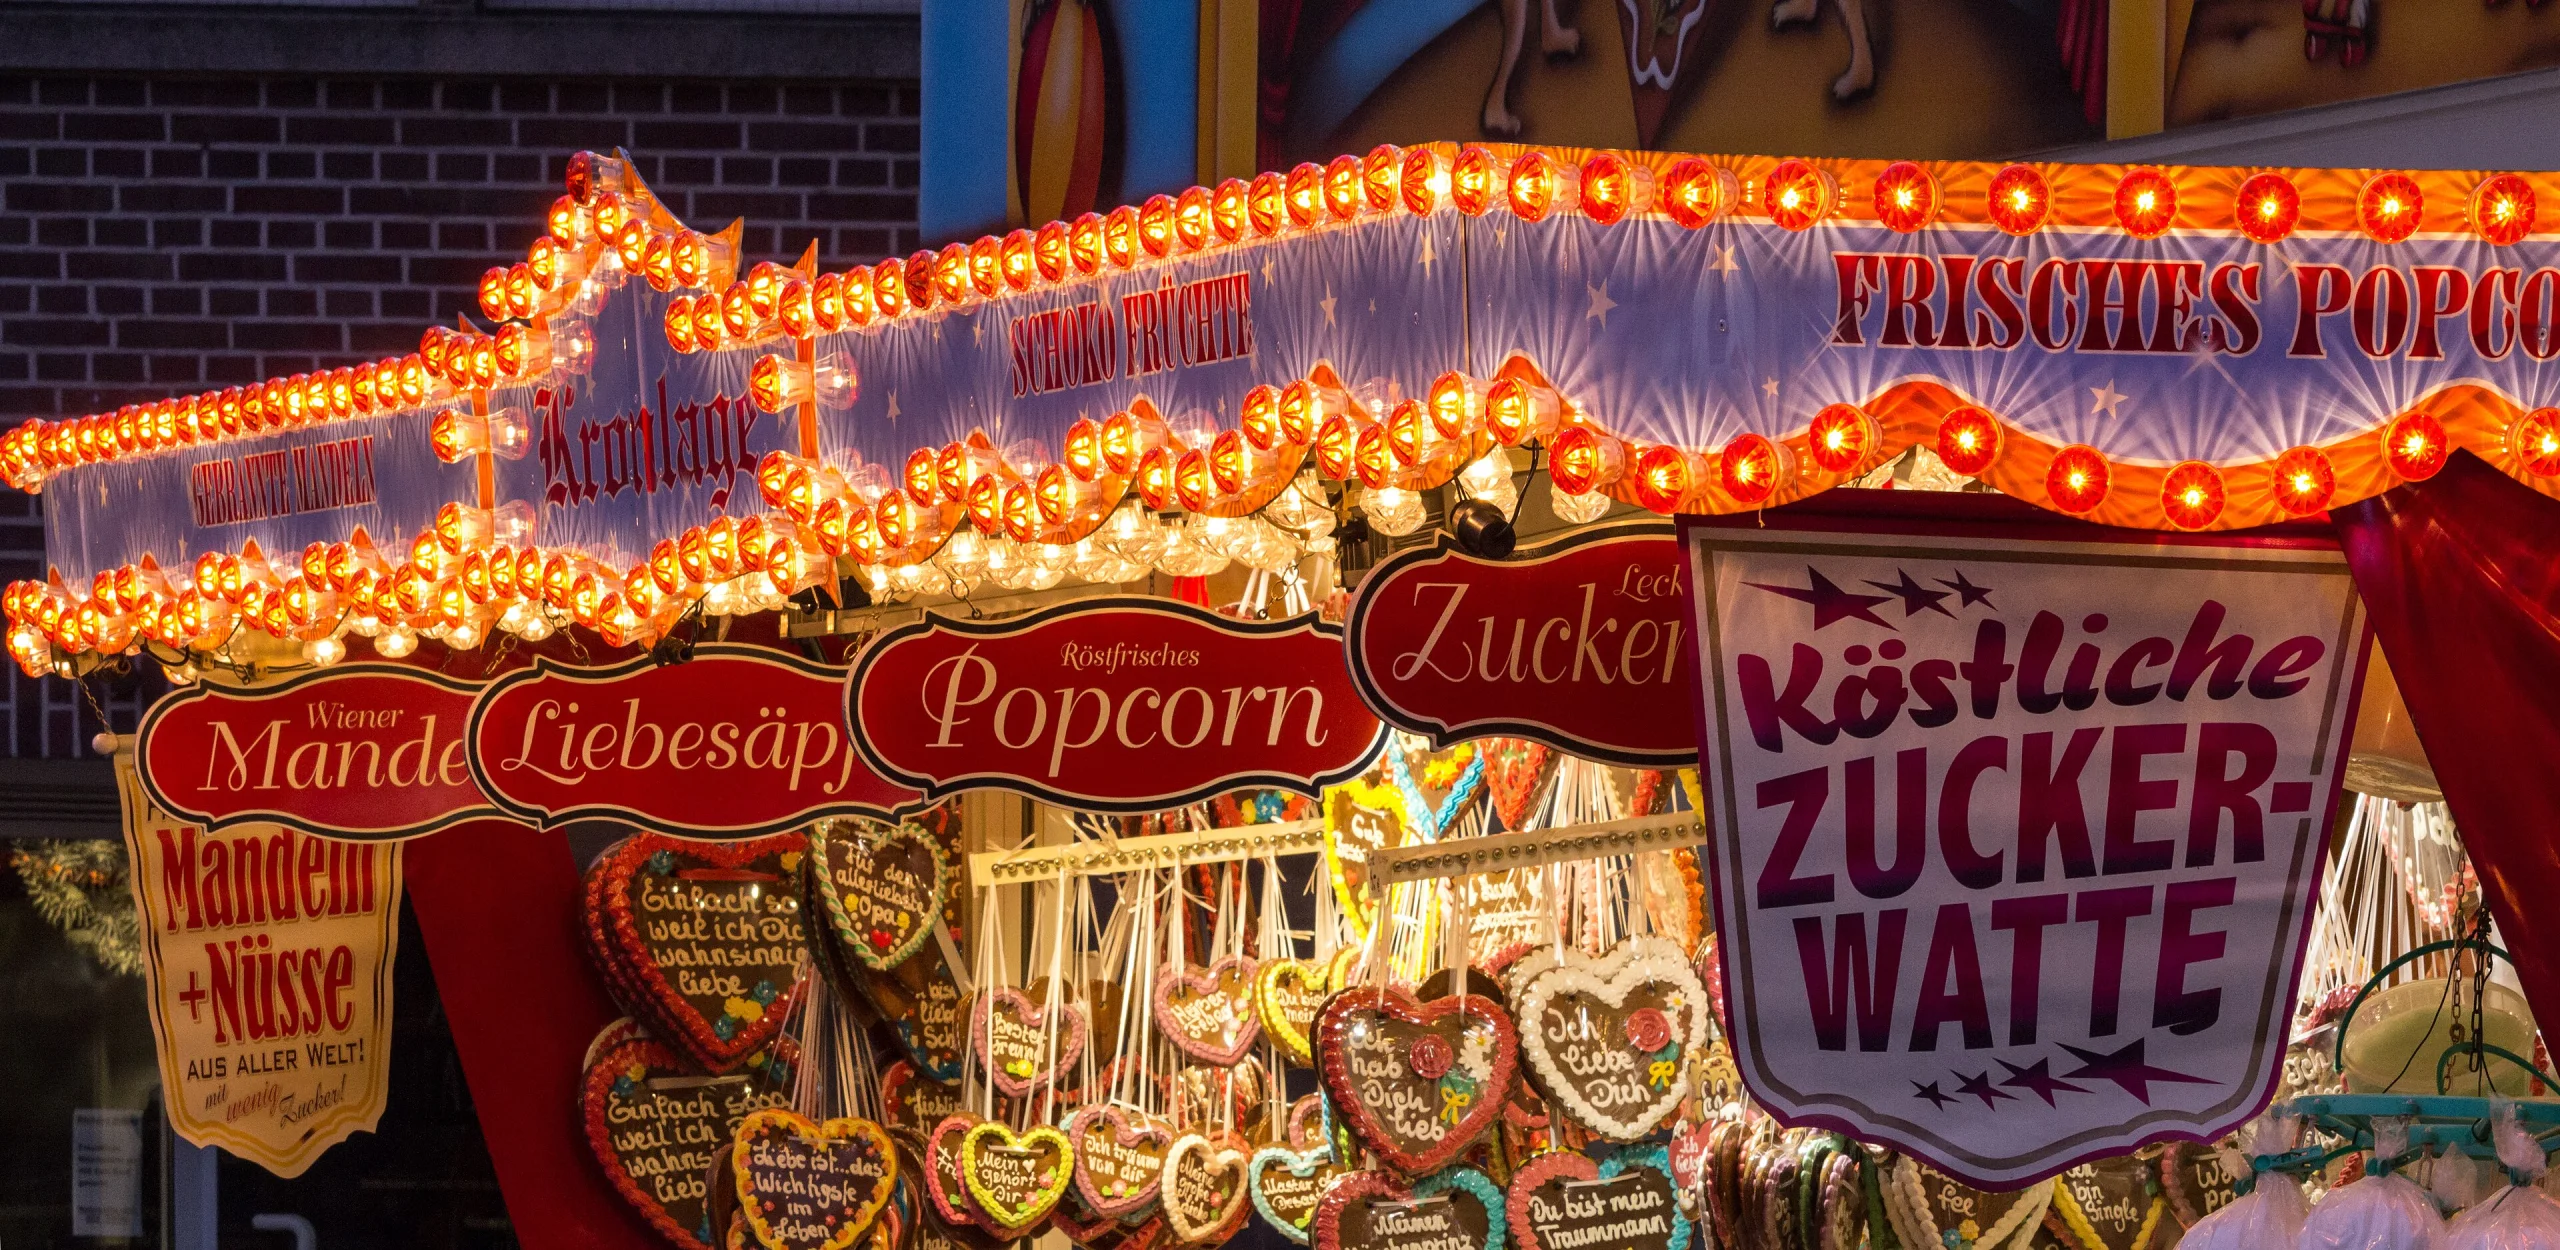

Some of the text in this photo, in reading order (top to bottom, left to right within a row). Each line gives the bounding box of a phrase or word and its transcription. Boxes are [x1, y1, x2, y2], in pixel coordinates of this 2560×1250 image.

[1832, 253, 2560, 362] FRISCHES POPCO
[1010, 270, 1253, 400] SCHOKO FRÜCHTE
[535, 374, 760, 515] Kronlage
[291, 434, 377, 515] MANDELN
[1392, 582, 1687, 685] Zucker
[1060, 642, 1200, 674] Röstfrisches
[1737, 600, 2326, 753] Köstliche
[307, 700, 403, 729] Wiener
[922, 643, 1329, 777] Popcorn
[1756, 722, 2312, 909] ZUCKER-
[156, 827, 376, 933] Mandeln
[642, 877, 762, 915] Einfach
[859, 895, 898, 926] Opa
[648, 914, 710, 941] weil
[714, 915, 758, 942] ich
[1793, 876, 2238, 1053] WATTE
[679, 969, 748, 996] liebe
[1277, 987, 1299, 1006] Du
[1547, 1004, 1601, 1042] Ich
[187, 1057, 227, 1080] AUS
[237, 1050, 298, 1075] ALLER
[1351, 1049, 1403, 1079] hab
[1560, 1041, 1635, 1076] liebe
[205, 1081, 281, 1122] mit wenig
[279, 1073, 346, 1129] Zucker!
[1361, 1079, 1431, 1113] Dich
[1585, 1074, 1651, 1108] Dich
[608, 1092, 720, 1126] Einfach
[614, 1123, 672, 1150] weil
[675, 1120, 721, 1144] ich
[1084, 1134, 1111, 1156] Ich
[1680, 1135, 1698, 1153] Ich
[753, 1139, 806, 1169] Liebe
[977, 1152, 1018, 1172] Mein
[1088, 1155, 1146, 1182] von dir
[981, 1168, 1036, 1188] gehört
[995, 1185, 1022, 1203] Dir
[2072, 1179, 2104, 1201] bin
[786, 1196, 812, 1216] im
[1528, 1184, 1665, 1223] Du bist mein
[2085, 1196, 2139, 1233] Single
[773, 1218, 830, 1242] Leben
[1536, 1214, 1669, 1250] Traummann
